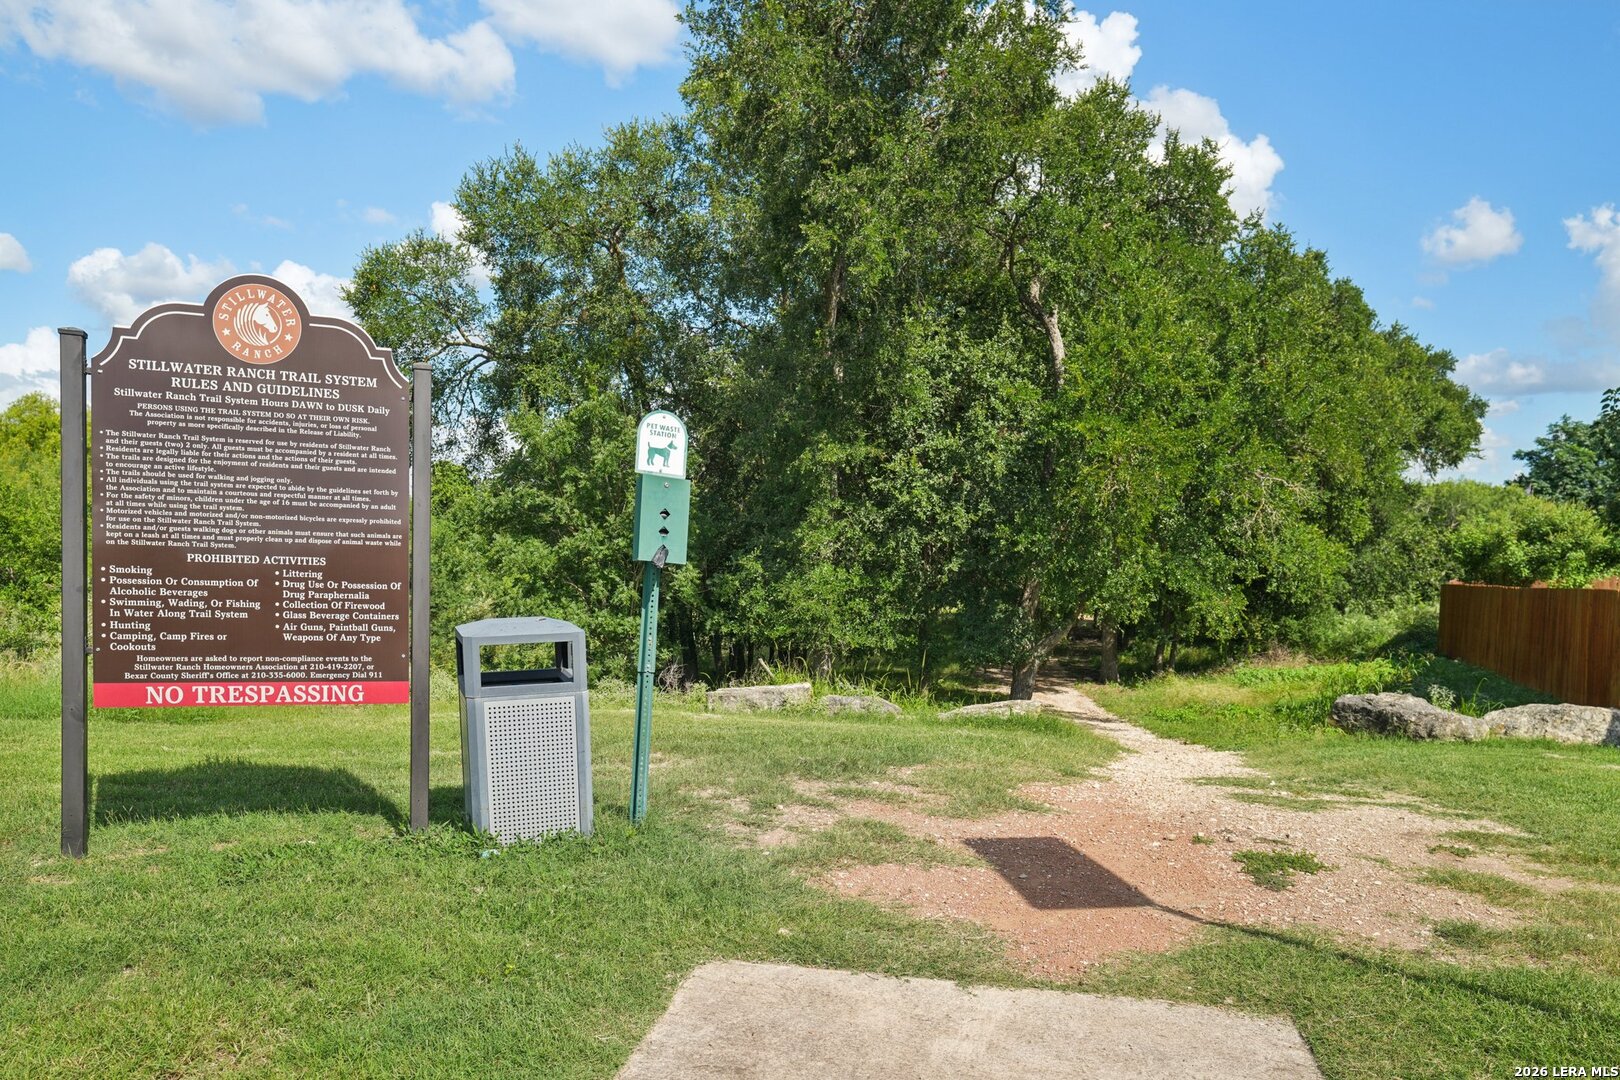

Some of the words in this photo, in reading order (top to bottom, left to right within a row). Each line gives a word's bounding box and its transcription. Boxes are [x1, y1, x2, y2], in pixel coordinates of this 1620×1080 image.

[218, 289, 296, 327] STILLWATER
[232, 341, 283, 358] RANCH
[128, 359, 222, 376] STILLWATER
[227, 366, 275, 380] RANCH
[279, 370, 321, 383] TRAIL
[325, 373, 377, 387] SYSTEM
[171, 377, 217, 391] RULES
[222, 380, 252, 393] AND
[257, 383, 339, 399] GUIDELINES
[114, 387, 162, 399] Stillwater
[166, 390, 196, 401] Ranch
[199, 392, 221, 402] Trail
[225, 394, 257, 407] System
[261, 396, 288, 407] Hours
[292, 398, 322, 409] DAWN
[326, 401, 335, 410] to
[338, 401, 364, 412] DUSK
[367, 403, 390, 416] Daily
[137, 403, 172, 412] PERSONS
[175, 405, 198, 413] USING
[217, 408, 240, 416] TRAIL
[242, 409, 271, 417] SYSTEM
[308, 413, 331, 421] THEIR
[145, 411, 184, 420] Association
[207, 415, 245, 425] responsible
[258, 418, 290, 427] accidents,
[292, 420, 318, 429] injuries,
[350, 423, 377, 433] personal
[650, 430, 676, 439] STATION
[660, 425, 681, 433] WASTE
[115, 462, 151, 471] encourage
[164, 463, 185, 471] active
[207, 473, 234, 482] walking
[250, 475, 274, 484] jogging
[106, 507, 142, 515] Motorized
[189, 510, 223, 518] motorized
[225, 512, 248, 520] and/or
[250, 513, 297, 521] non-motorized
[299, 514, 325, 524] bicycles
[338, 516, 367, 525] expressly
[369, 517, 401, 526] prohibited
[187, 554, 259, 564] PROHIBITED
[263, 555, 326, 566] ACTIVITIES
[109, 566, 152, 577] Smoking
[283, 569, 322, 580] Littering
[109, 577, 162, 585] Possession
[165, 577, 177, 586] Or
[181, 578, 243, 589] Consumption
[246, 579, 258, 587] Of
[283, 580, 305, 591] Drug
[308, 580, 324, 589] Use
[327, 581, 338, 589] Or
[341, 581, 387, 589] Possession
[390, 581, 401, 590] Of
[109, 587, 156, 596] Alcoholic
[159, 588, 208, 599] Beverages
[283, 590, 305, 601] Drug
[308, 591, 369, 602] Paraphernalia
[109, 598, 164, 609] Swimming,
[168, 599, 207, 610] Wading,
[210, 600, 222, 608] Or
[226, 600, 260, 610] Fishing
[282, 601, 328, 609] Collection
[331, 601, 343, 609] Of
[344, 601, 385, 610] Firewood
[109, 609, 120, 617] In
[124, 609, 153, 618] Water
[157, 610, 185, 620] Along
[188, 610, 211, 618] Trail
[214, 610, 248, 621] System
[282, 611, 306, 619] Glass
[309, 611, 349, 622] Beverage
[352, 611, 399, 620] Containers
[110, 621, 150, 631] Hunting
[283, 623, 297, 631] Air
[300, 623, 325, 632] Guns,
[329, 623, 368, 631] Paintball
[371, 623, 395, 632] Guns,
[109, 632, 156, 642] Camping,
[159, 632, 187, 642] Camp
[190, 632, 214, 640] Fires
[283, 633, 323, 643] Weapons
[326, 633, 338, 641] Of
[339, 633, 357, 644] Any
[360, 633, 381, 644] Type
[110, 642, 155, 651] Cookouts
[239, 655, 263, 664] report
[265, 655, 323, 664] non-compliance
[310, 663, 364, 671] 210-419-2207,
[150, 672, 178, 681] County
[310, 671, 350, 680] Emergency
[146, 687, 183, 704] NO
[192, 685, 364, 703] TRESPASSING
